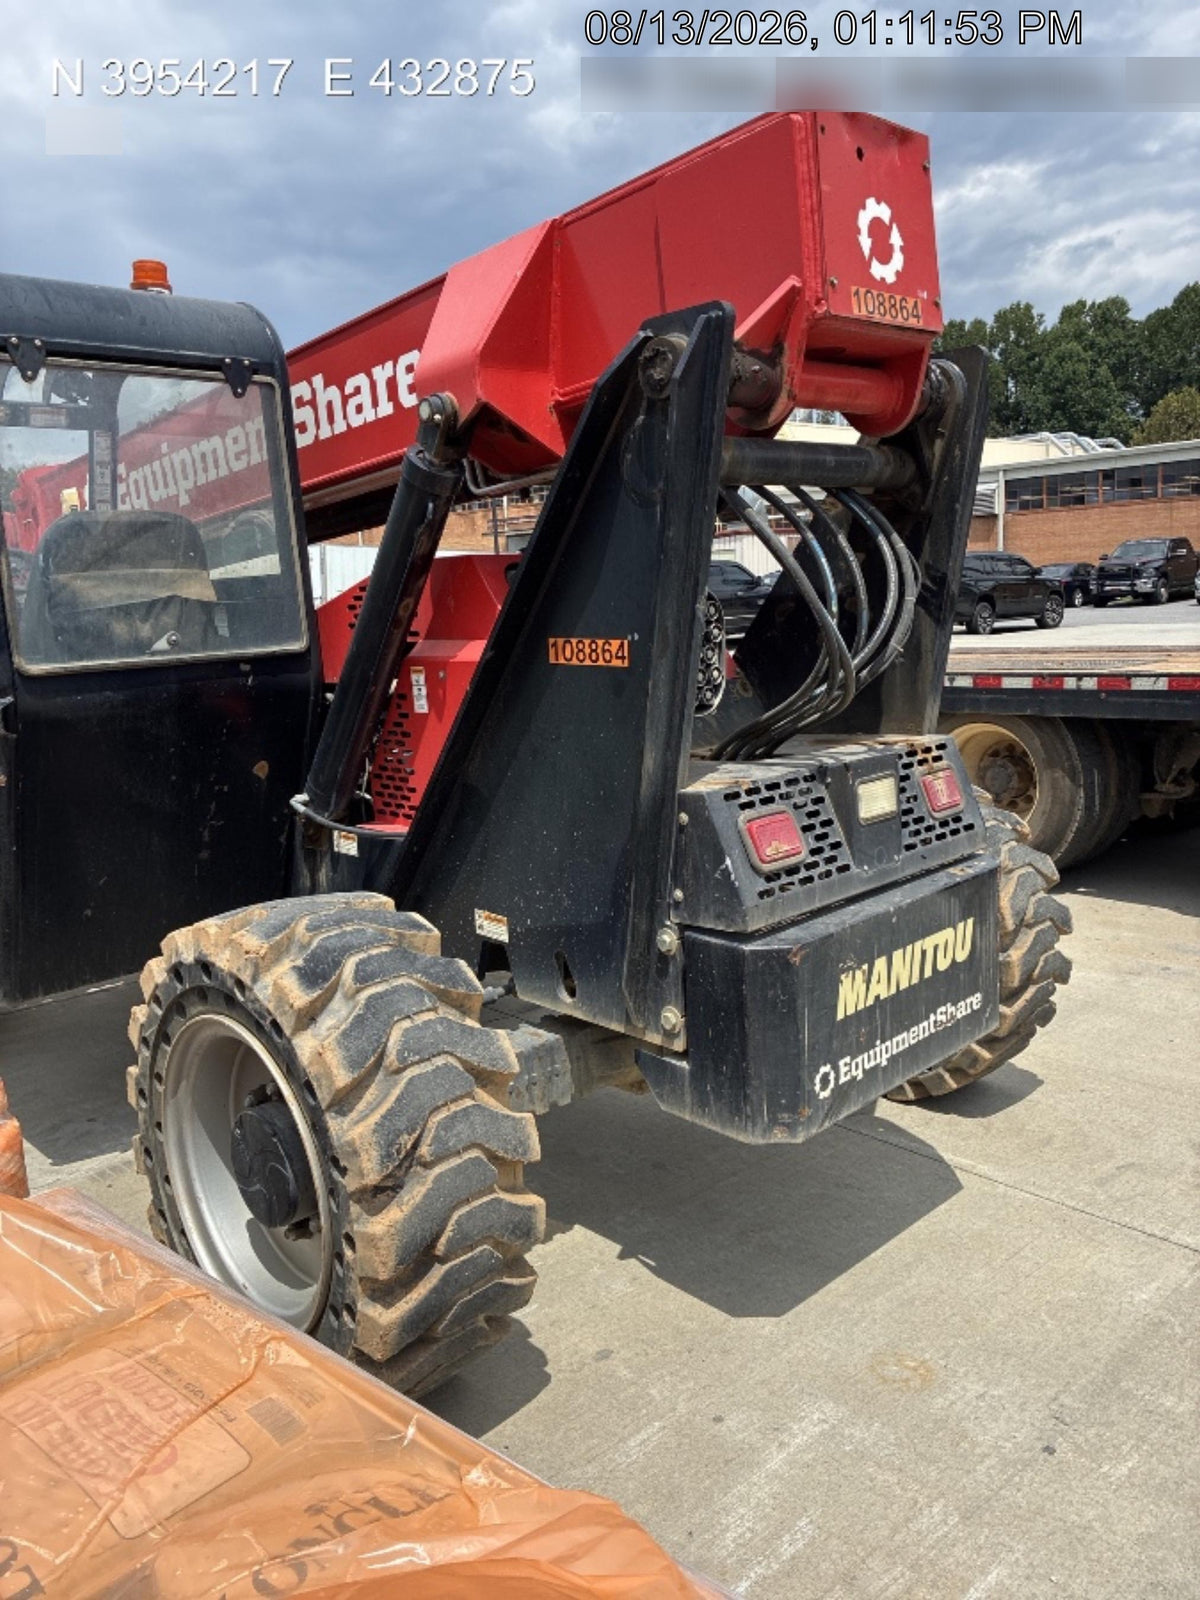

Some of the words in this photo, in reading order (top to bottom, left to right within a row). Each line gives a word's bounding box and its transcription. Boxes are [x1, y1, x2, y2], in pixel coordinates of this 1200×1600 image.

[852, 286, 922, 325] 108864
[549, 637, 629, 666] 108864
[836, 917, 976, 1022] MANITOU
[837, 990, 984, 1086] EquipmentShare
